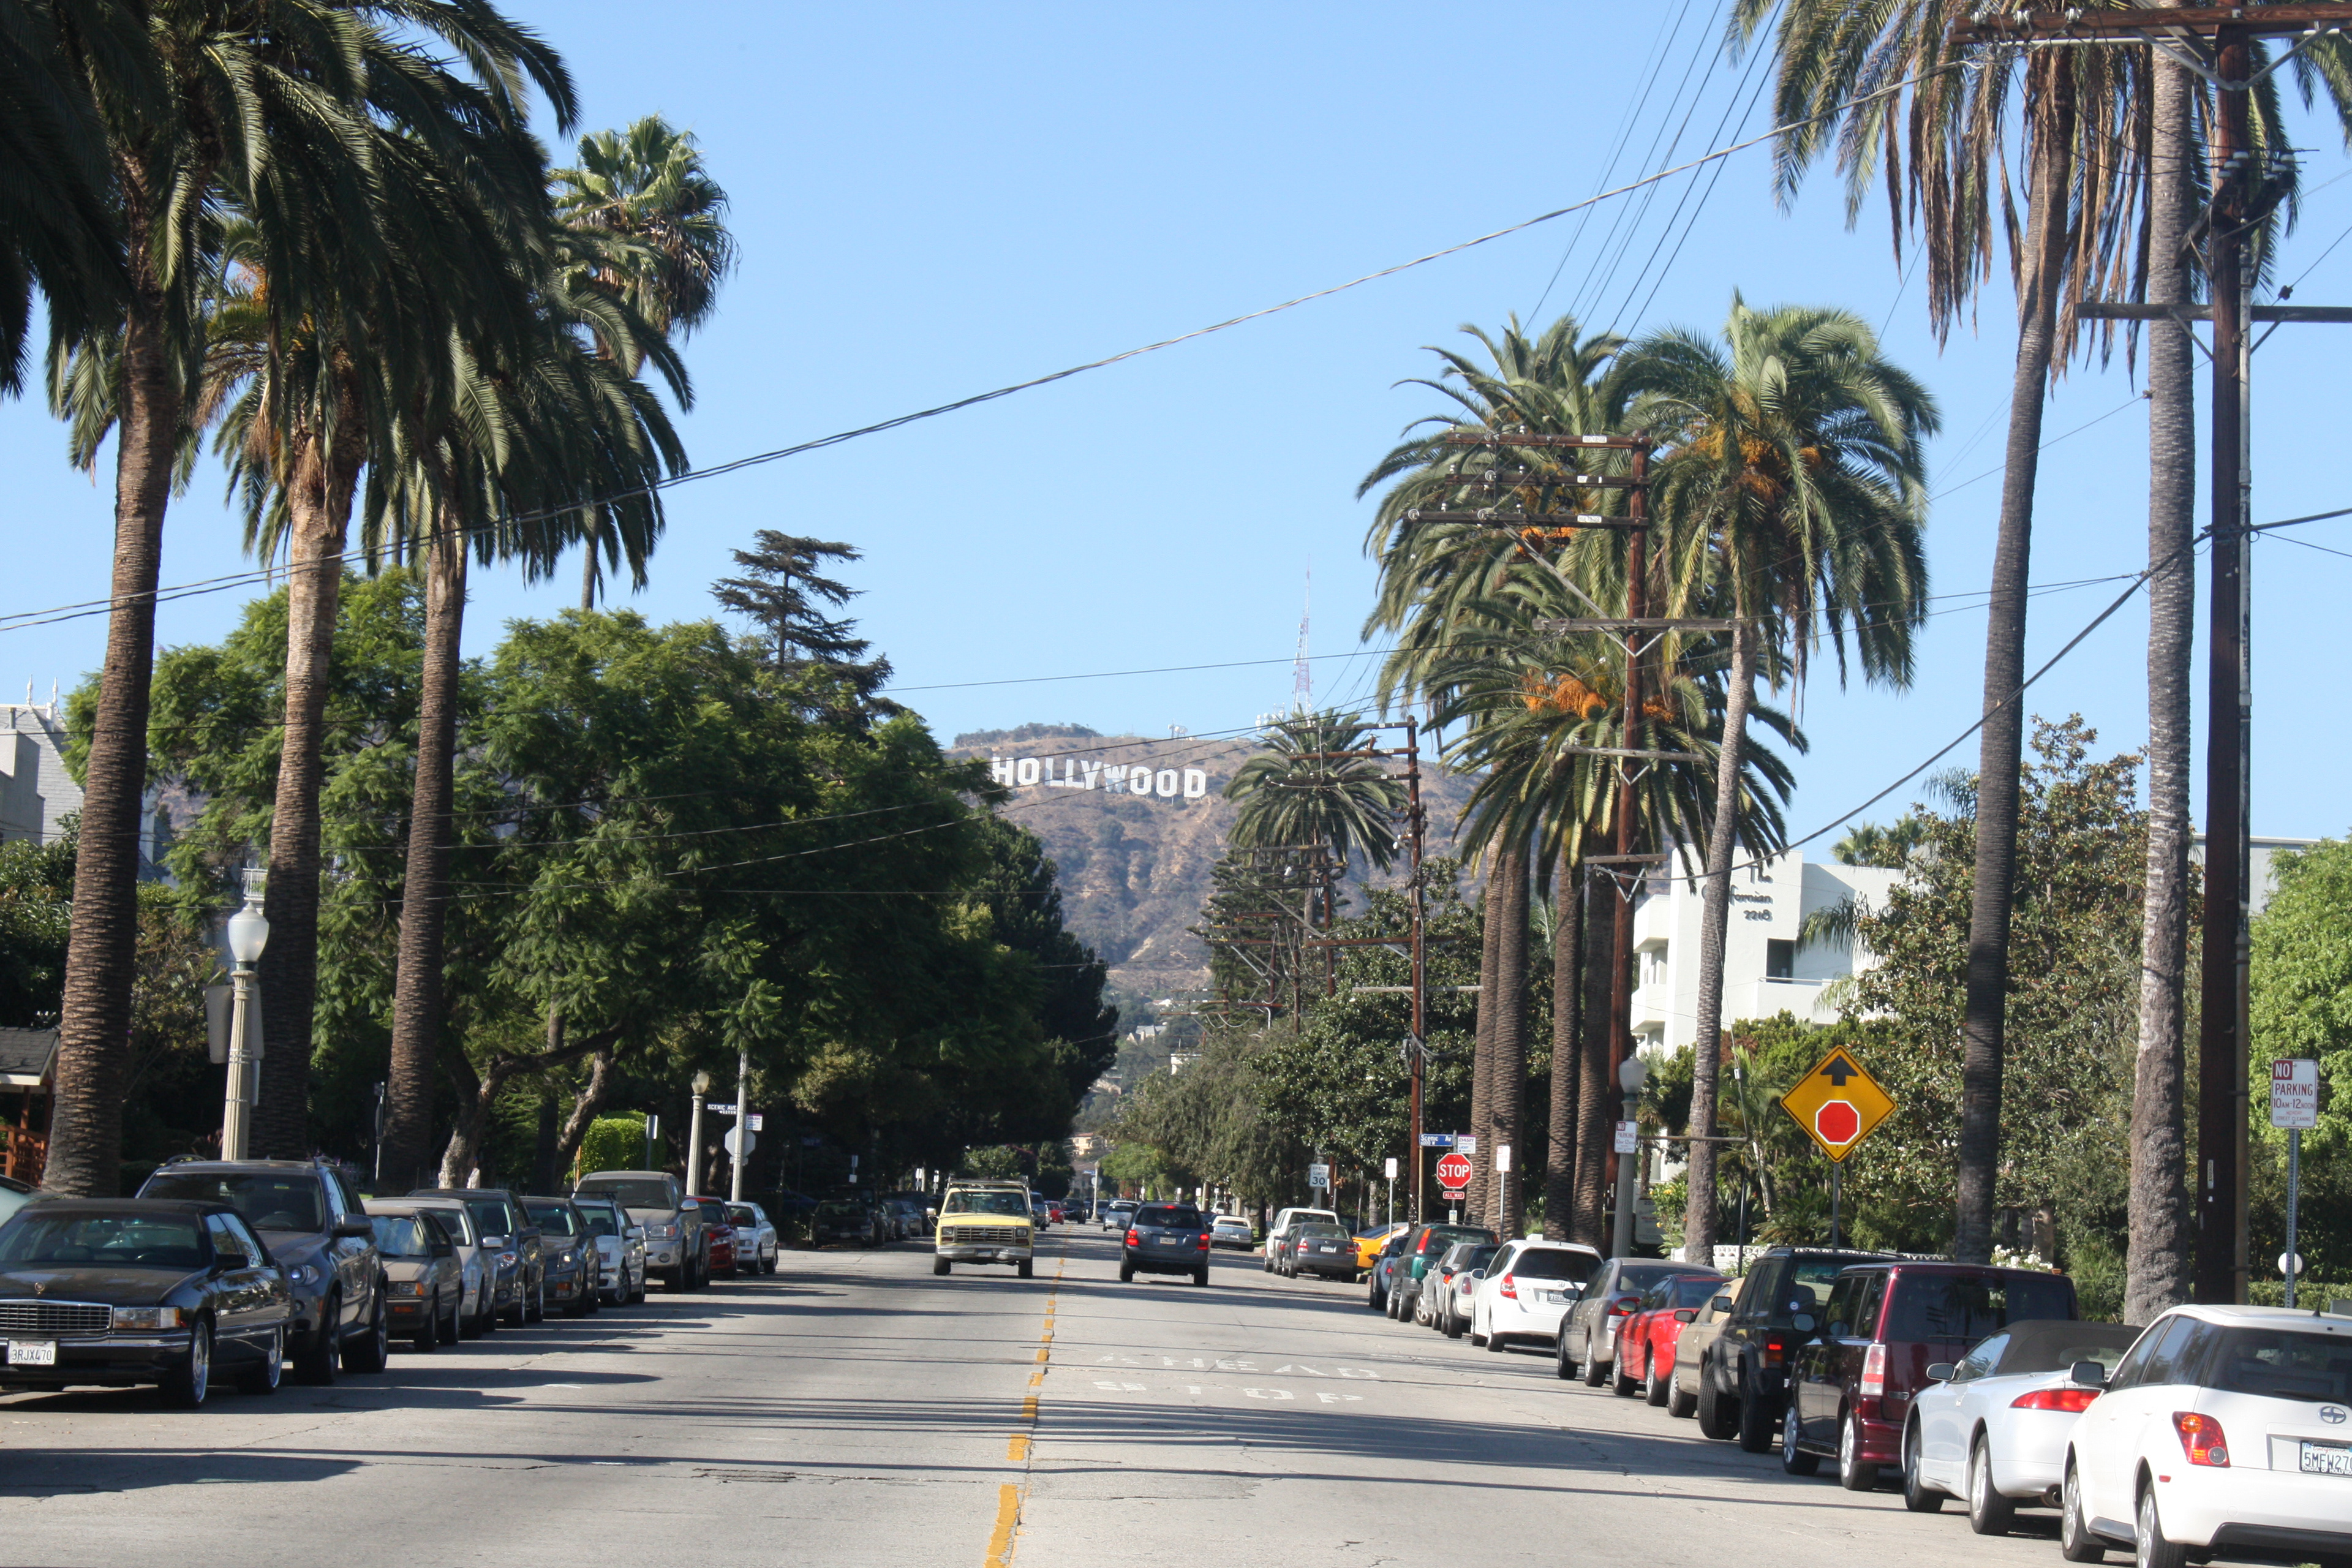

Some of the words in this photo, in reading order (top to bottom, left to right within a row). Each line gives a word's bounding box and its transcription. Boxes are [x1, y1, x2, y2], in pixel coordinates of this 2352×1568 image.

[992, 756, 1206, 798] HOLLYWOOD
[1743, 910, 1773, 922] 2218
[2275, 1063, 2290, 1077] NO
[2275, 1083, 2313, 1096] PARKING
[1439, 1164, 1469, 1177] STOP
[1312, 1177, 1325, 1185] 30
[12, 1349, 51, 1360] 3RJX470
[1096, 1352, 1379, 1378] AHEAD
[1093, 1381, 1364, 1403] STOP
